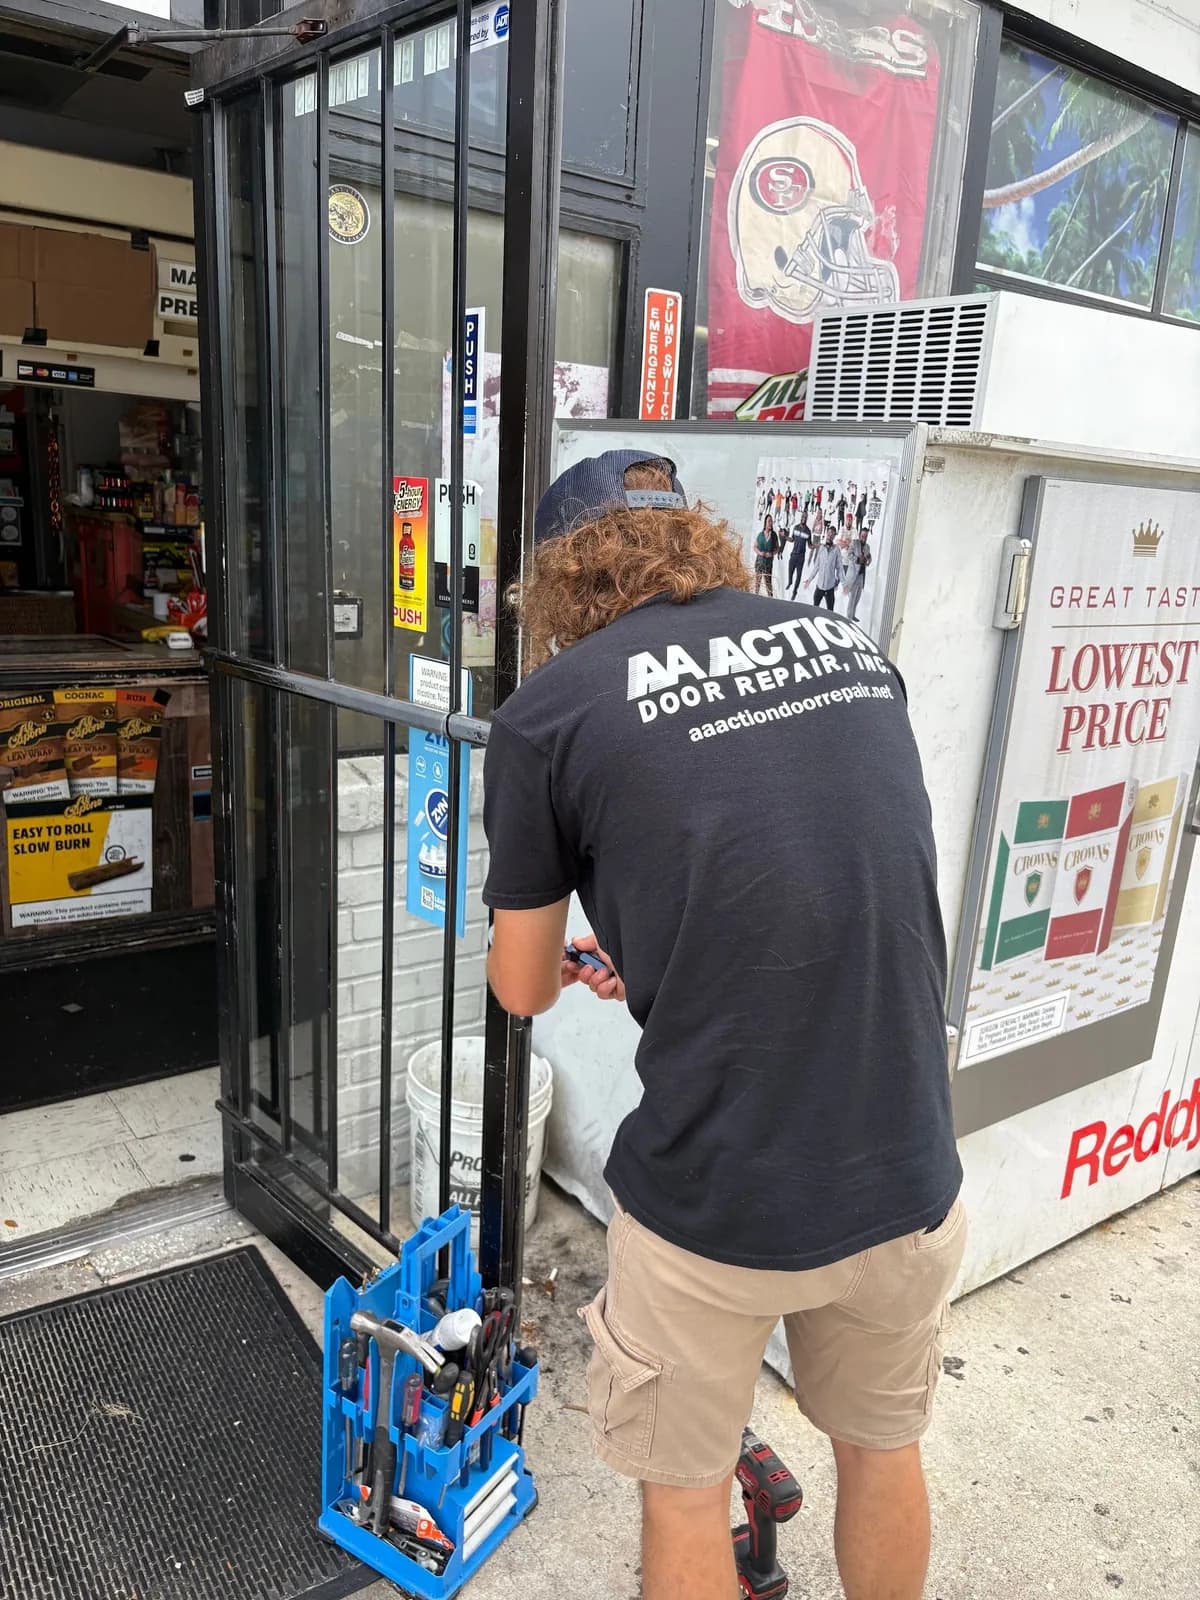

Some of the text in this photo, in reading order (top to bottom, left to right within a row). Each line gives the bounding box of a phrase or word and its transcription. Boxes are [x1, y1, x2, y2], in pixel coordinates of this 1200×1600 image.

[465, 321, 475, 394] PUSH
[645, 307, 661, 414] EMERGENCY
[661, 297, 674, 420] PUMP SWITC
[396, 496, 422, 511] ENERGY
[439, 484, 475, 505] PH
[1050, 586, 1134, 608] GREAT
[393, 606, 422, 625] PUSH
[626, 616, 878, 701] AA ACTION
[1045, 640, 1200, 693] LOWEST
[64, 691, 105, 700] COGNAC
[126, 693, 146, 702] RUM
[638, 651, 891, 724] DOOR REPAIR, INC.
[688, 682, 894, 742] aaactiondoorrepair.net
[1056, 697, 1171, 754] PRICE
[29, 749, 54, 761] WRAP
[13, 822, 94, 840] EASY TO ROLL
[1128, 827, 1166, 852] CROWNS
[13, 838, 90, 855] SLOW BURN
[1064, 842, 1112, 872] CROWNS
[1013, 849, 1059, 876] CROWNS
[448, 1191, 472, 1205] ALL
